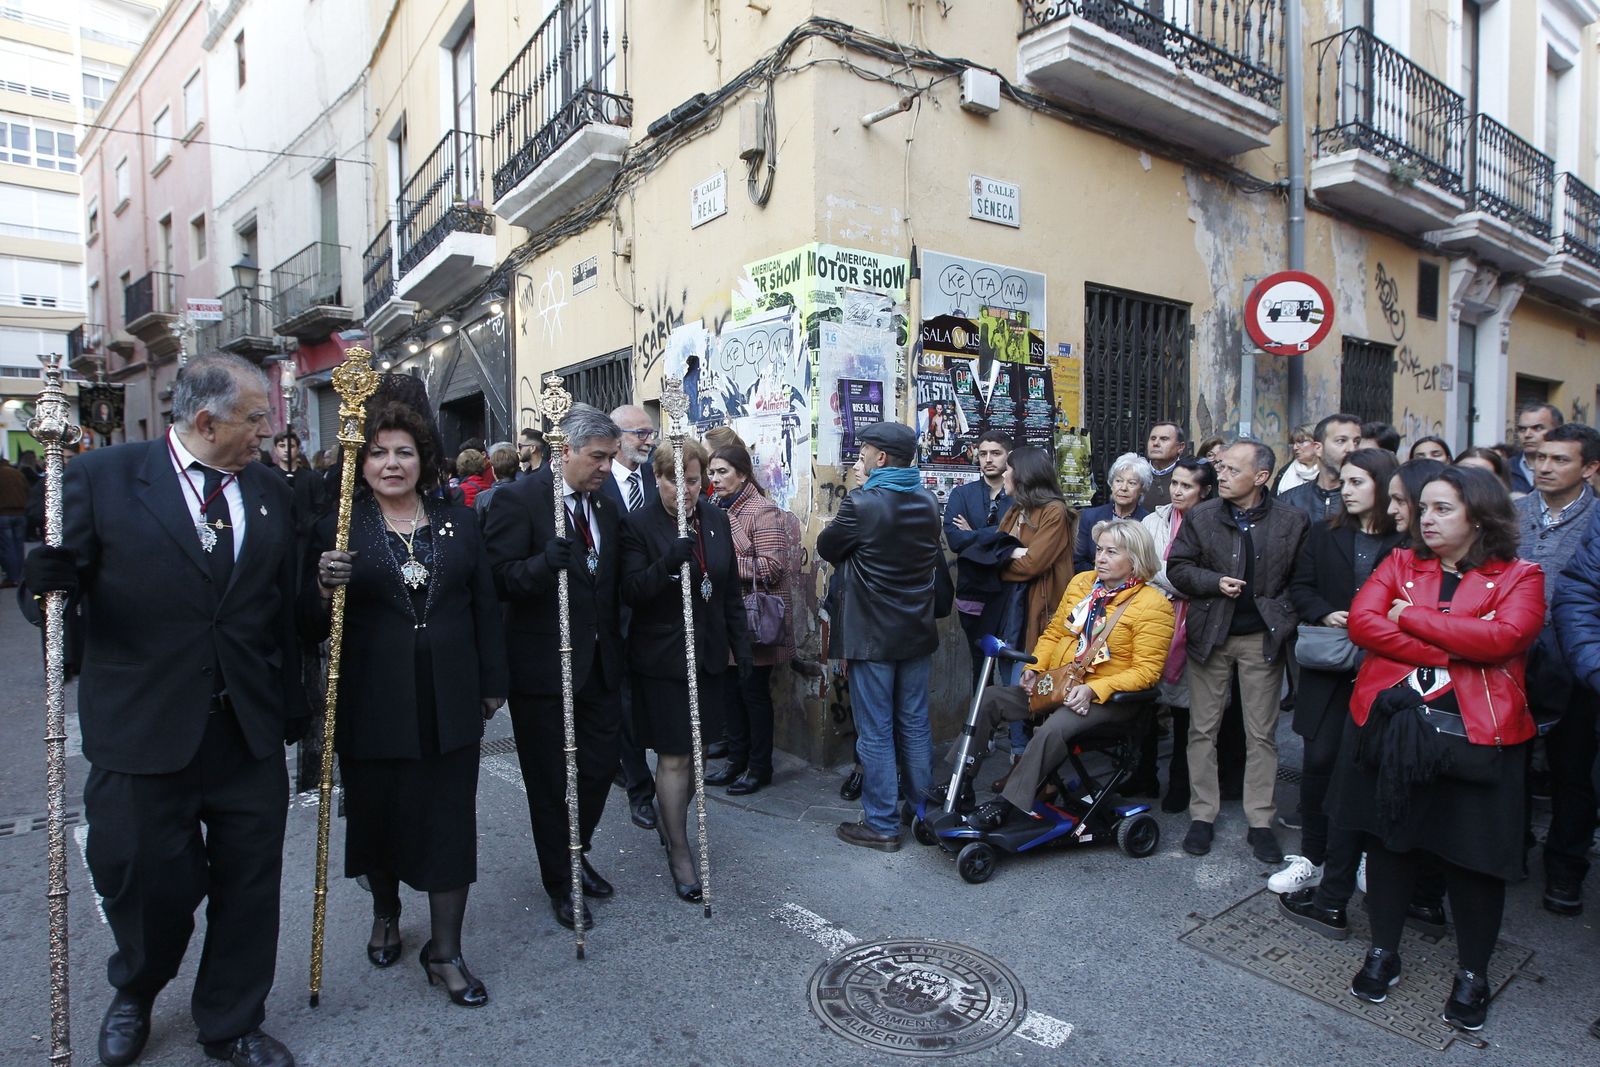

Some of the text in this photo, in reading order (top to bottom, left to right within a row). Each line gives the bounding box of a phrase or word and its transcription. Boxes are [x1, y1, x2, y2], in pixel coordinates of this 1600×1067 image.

[701, 178, 721, 195] CALLE
[987, 183, 1015, 198] CALLE
[698, 197, 717, 219] REAL
[977, 197, 1014, 220] SÉNECA
[752, 259, 781, 276] AMERICAN
[835, 251, 879, 268] AMERICAN
[770, 253, 801, 291] SHOW
[807, 250, 906, 289] MOTOR SHOW
[977, 277, 996, 293] TA
[1005, 283, 1025, 301] MA
[825, 332, 837, 342] 16
[923, 327, 951, 344] SALA
[752, 455, 760, 465] 16
[842, 1016, 916, 1046] ALMERIA
